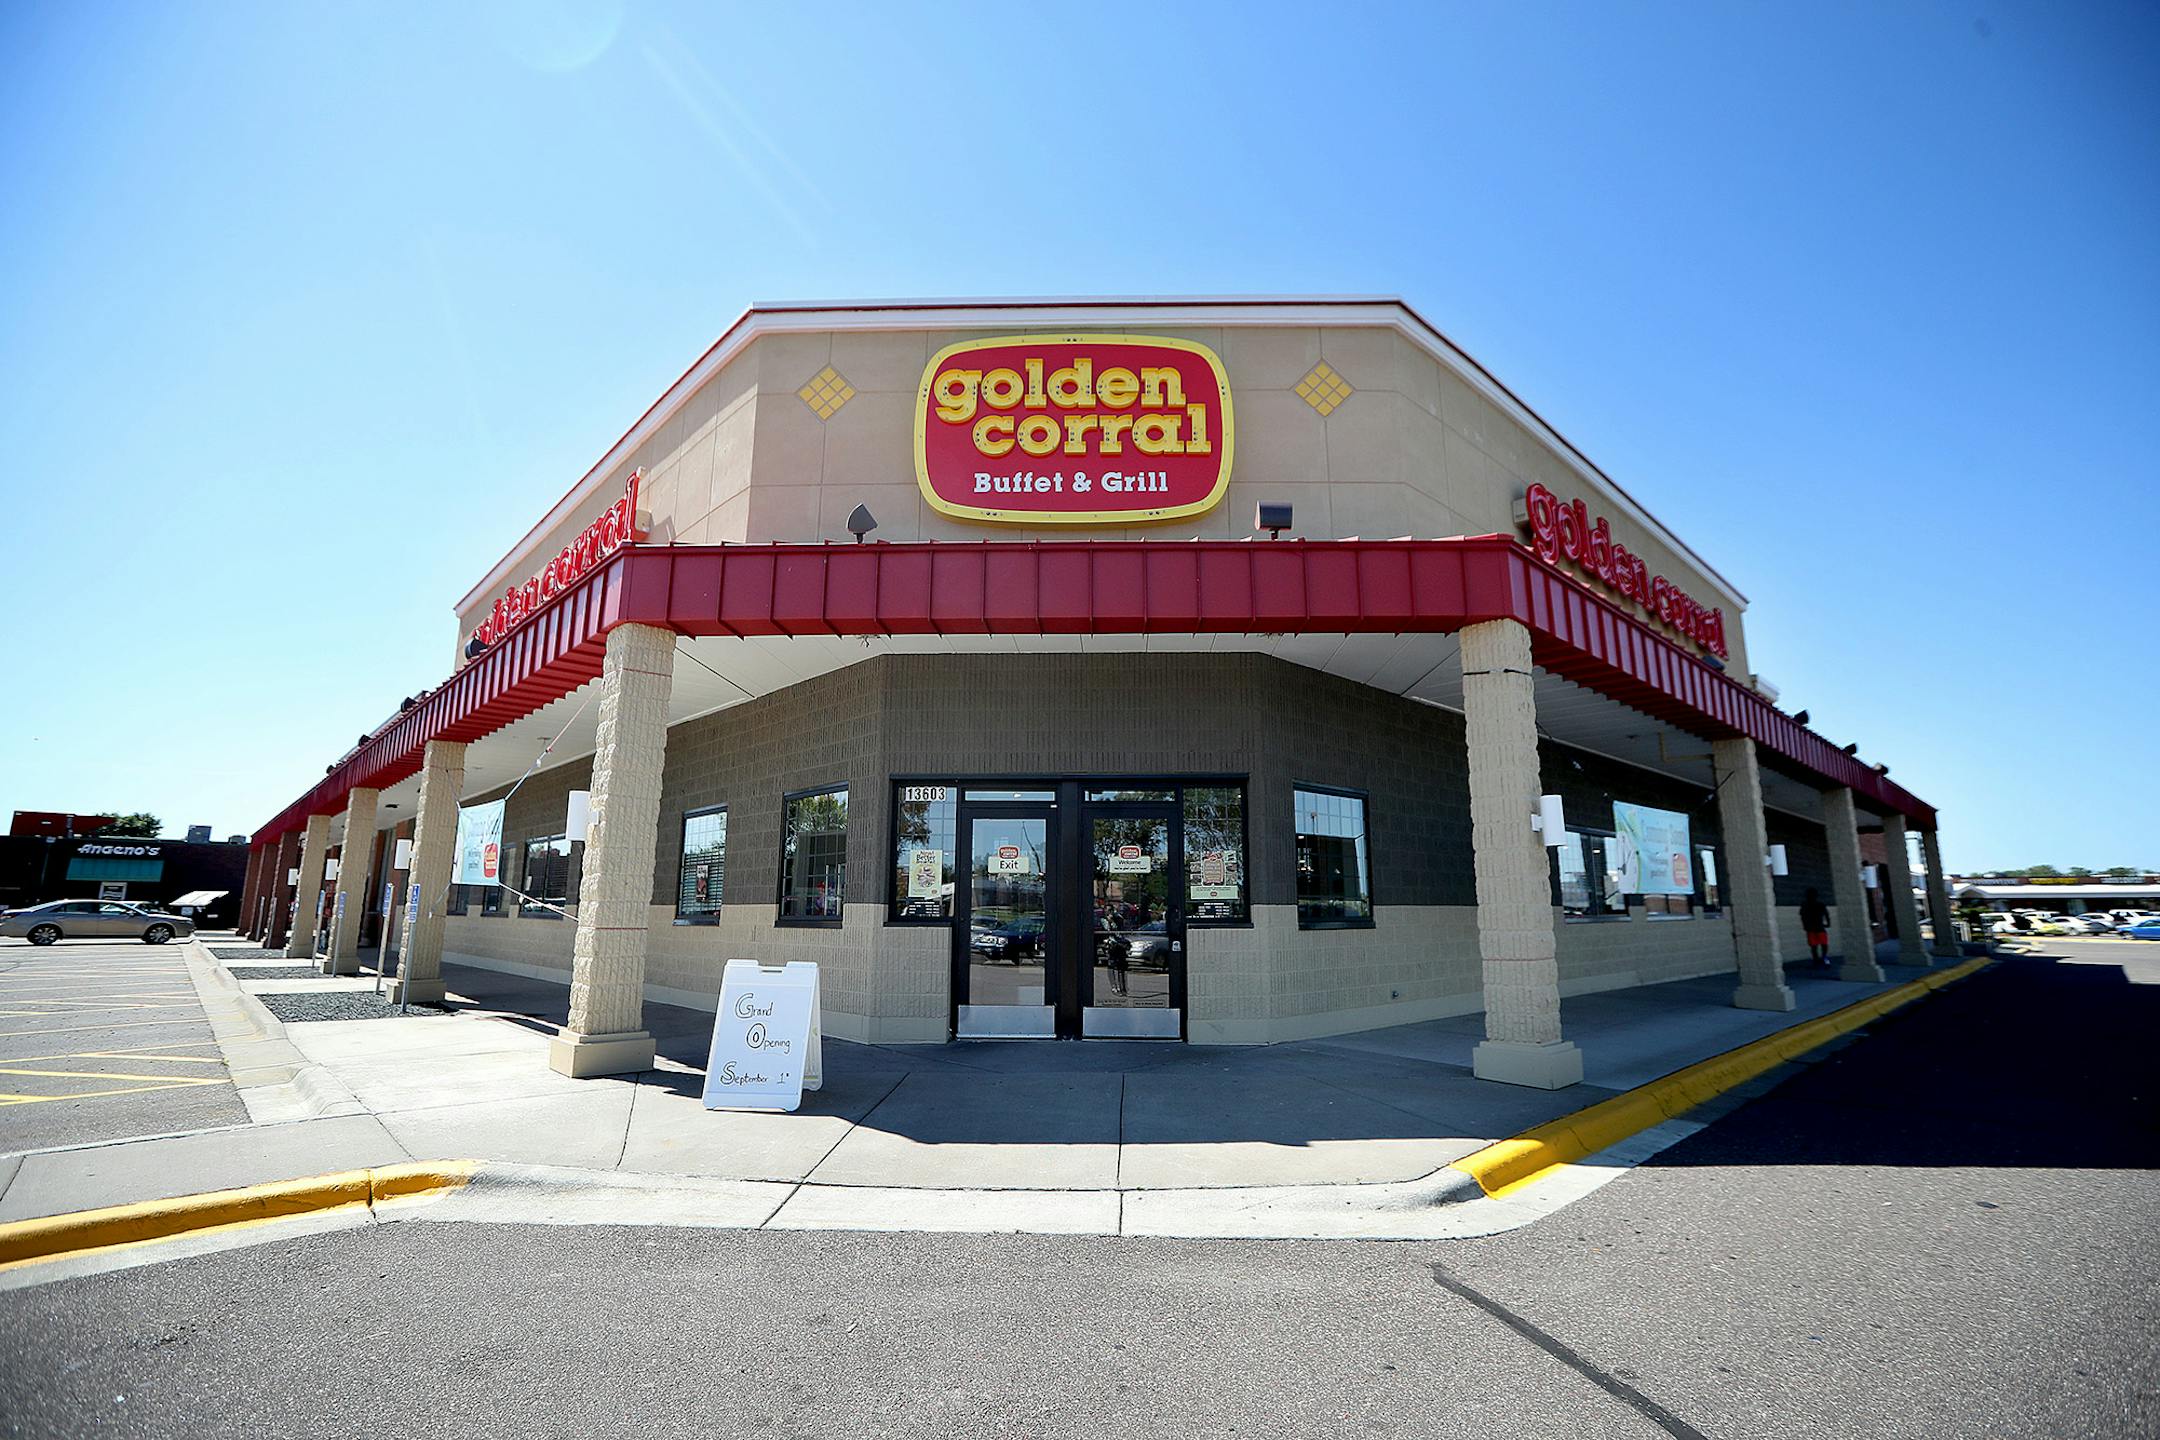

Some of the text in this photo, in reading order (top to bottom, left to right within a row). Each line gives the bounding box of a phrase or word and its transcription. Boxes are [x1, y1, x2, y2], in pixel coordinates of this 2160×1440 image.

[934, 358, 1187, 424] golden
[972, 403, 1212, 456] corral
[973, 472, 1169, 493] Buffet & Grill
[1526, 482, 1654, 611] golden
[907, 787, 946, 800] 13603
[1000, 860, 1018, 869] Exit
[734, 992, 774, 1019] Grand
[746, 1022, 791, 1055] Opening
[720, 1060, 768, 1086] September
